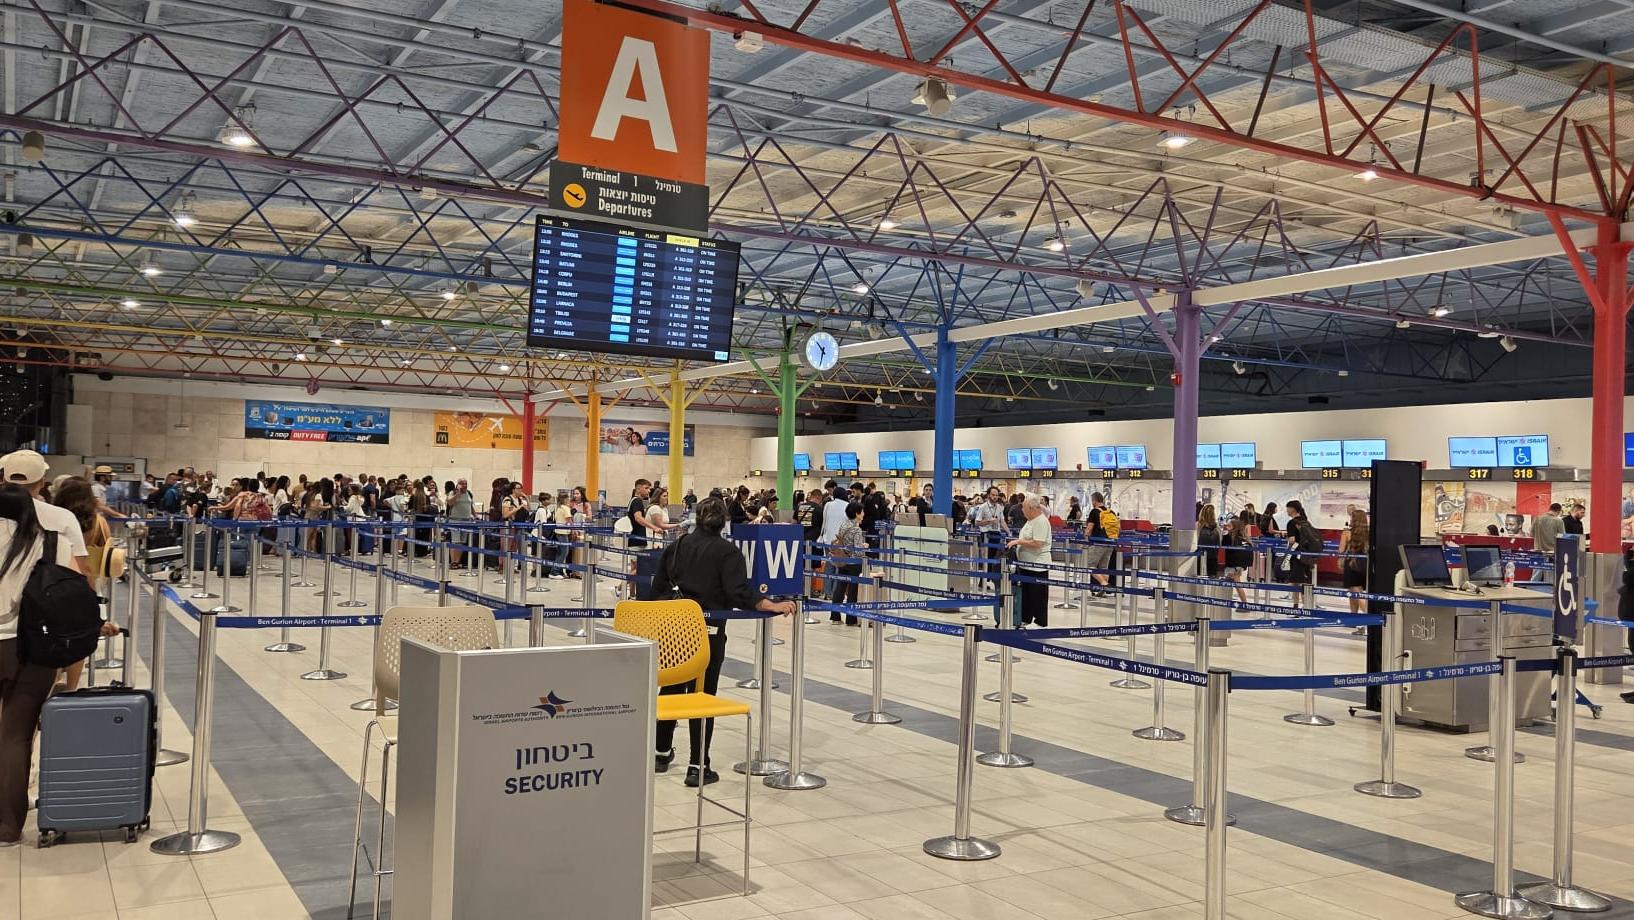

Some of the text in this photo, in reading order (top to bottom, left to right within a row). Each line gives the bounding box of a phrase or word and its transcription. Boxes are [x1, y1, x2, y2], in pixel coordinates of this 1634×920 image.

[590, 36, 678, 153] A
[582, 167, 638, 186] Terminal 1
[655, 180, 681, 193] טרמינל
[599, 187, 656, 205] טיסות יוצאות
[599, 198, 652, 218] Departures
[323, 415, 342, 424] ללא
[1469, 469, 1488, 478] 317
[1513, 469, 1533, 478] 318
[764, 540, 800, 578] W
[294, 618, 316, 626] Airport
[1052, 648, 1067, 657] Gurion
[1068, 651, 1085, 662] Airport
[1089, 656, 1109, 666] Terminal
[1138, 664, 1159, 674] טרמינל
[1165, 669, 1189, 681] בן-גוריון
[1443, 668, 1463, 676] טרמינל
[1470, 667, 1491, 675] בן-גוריון
[1190, 673, 1207, 684] עופה
[1346, 676, 1367, 685] Gurion
[1368, 674, 1388, 684] Airport
[1392, 672, 1417, 681] Terminal
[516, 743, 595, 770] ביטחון
[505, 768, 604, 794] SECURITY
